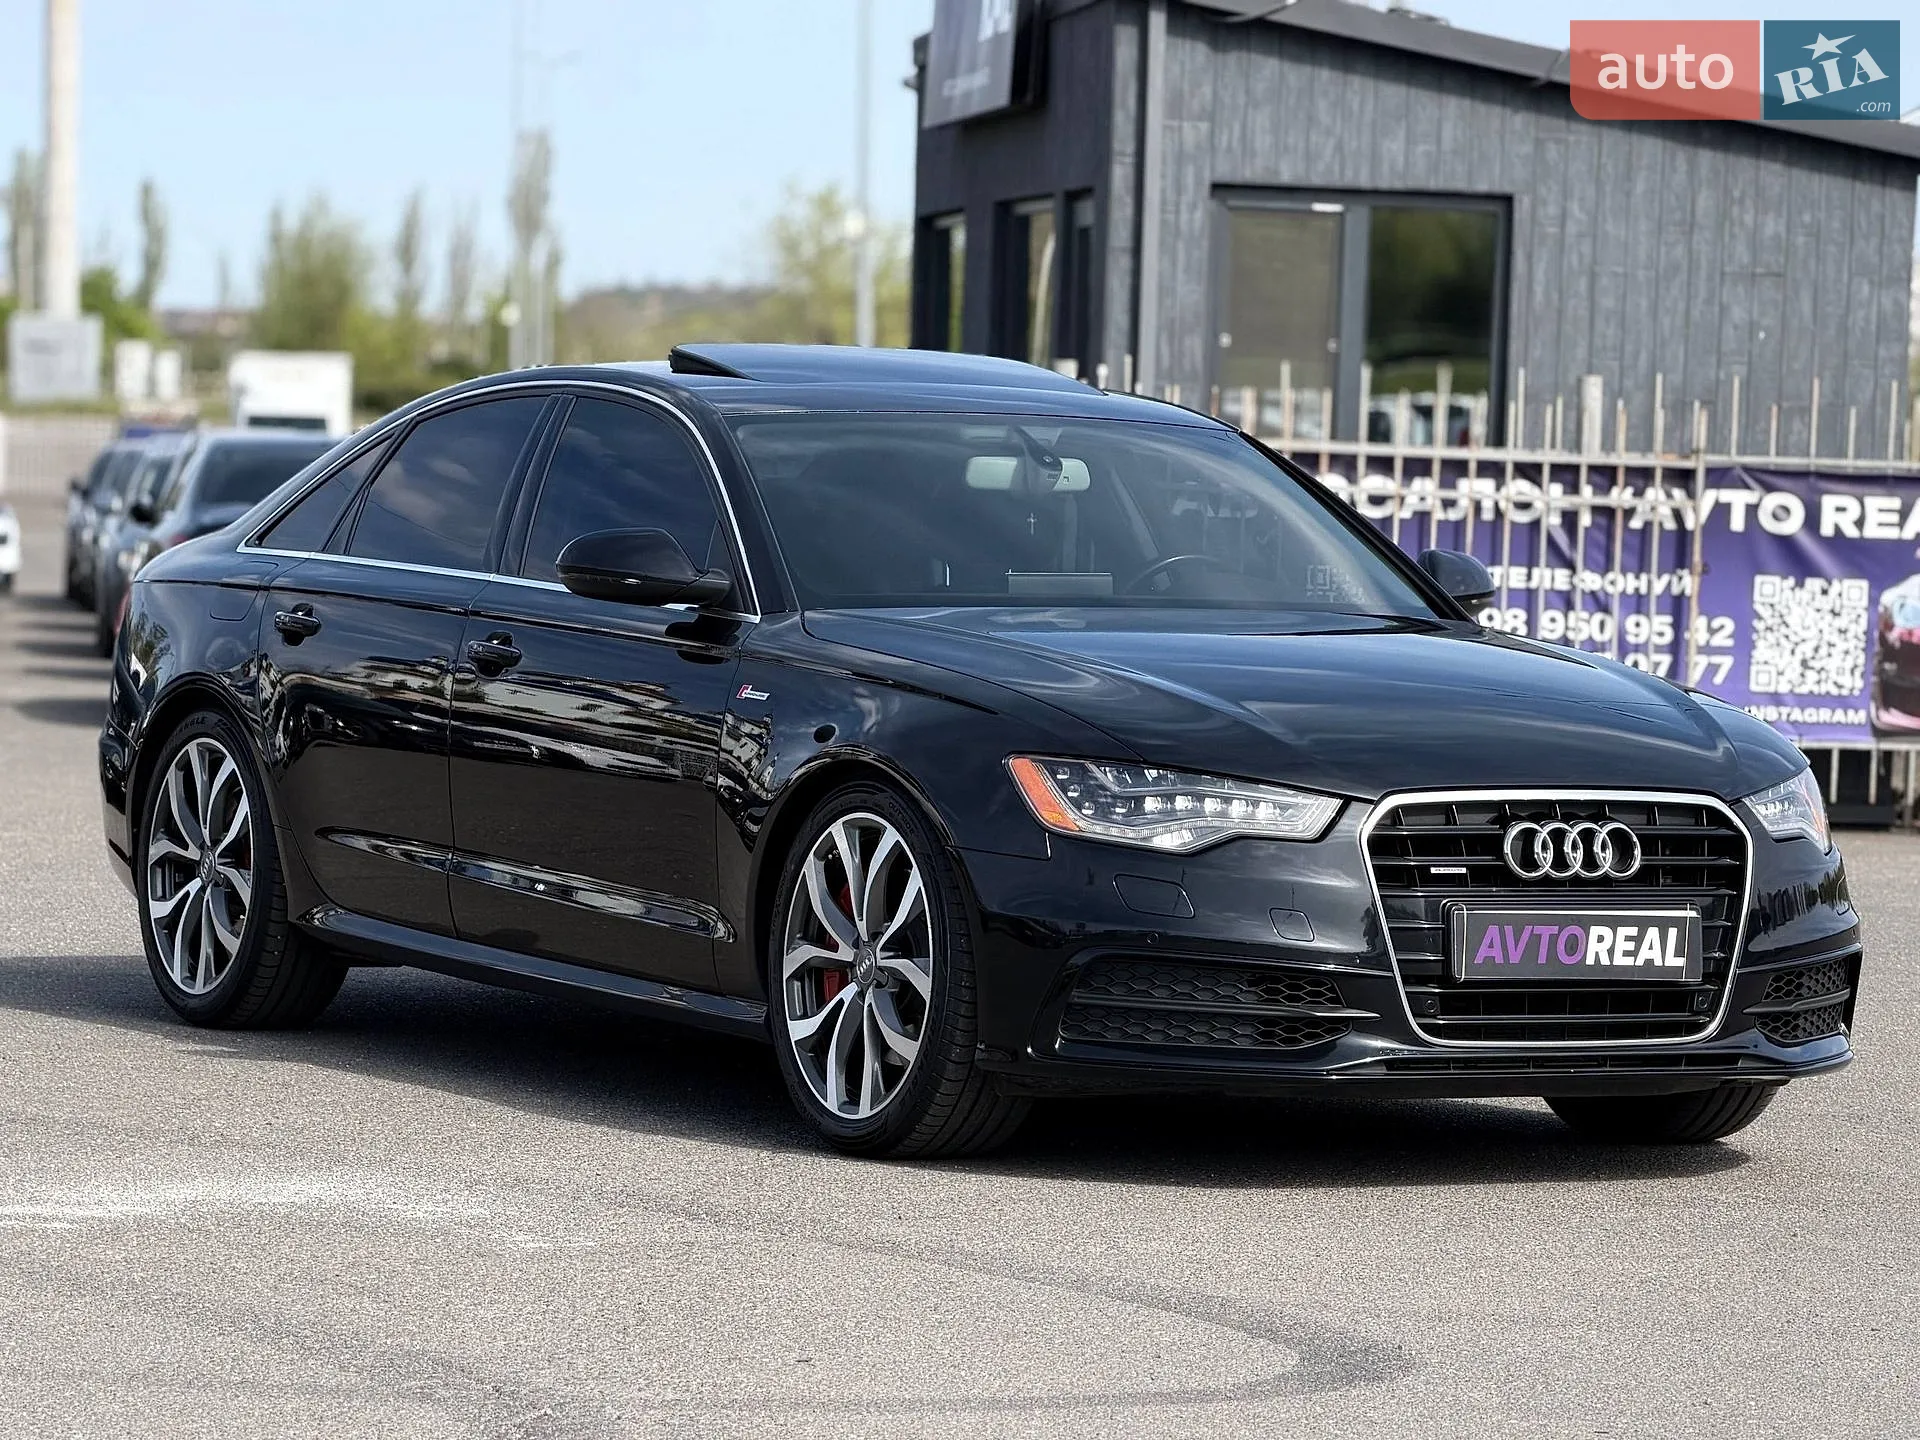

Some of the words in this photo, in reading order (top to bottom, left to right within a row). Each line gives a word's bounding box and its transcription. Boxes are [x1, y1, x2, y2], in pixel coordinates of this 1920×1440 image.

[1541, 609, 1614, 642] 950
[1624, 613, 1675, 645] 95
[1685, 615, 1736, 647] 42
[1689, 654, 1735, 687] 77
[1473, 925, 1685, 967] AVTOREAL
